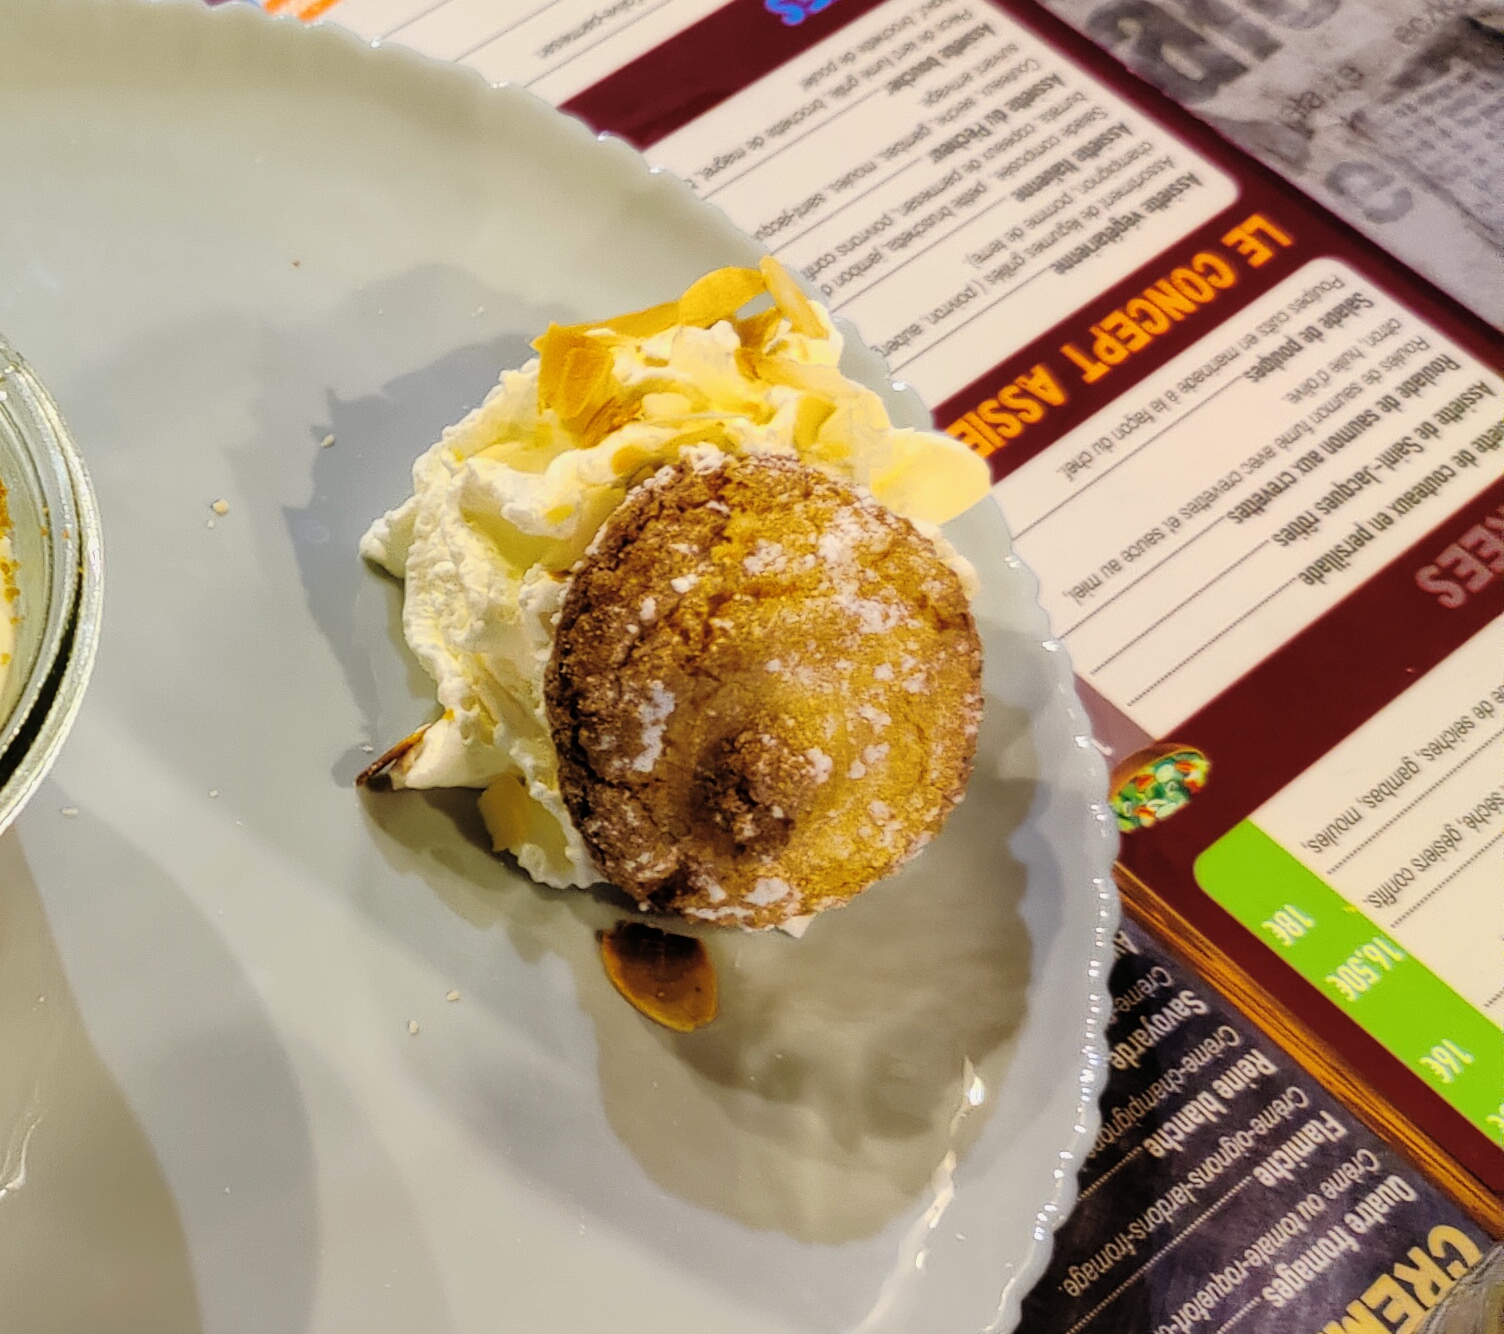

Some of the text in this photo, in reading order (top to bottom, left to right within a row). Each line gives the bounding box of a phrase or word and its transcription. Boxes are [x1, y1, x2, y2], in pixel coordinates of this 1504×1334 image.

[1143, 173, 1202, 213] Assiette
[1288, 274, 1346, 314] Poulpes
[941, 215, 1291, 458] LE CONCEPT ASSIE
[1237, 332, 1259, 351] en
[1242, 292, 1374, 383] Salade de poulpes
[1177, 348, 1240, 394] marinade
[1328, 347, 1366, 374] huile
[1361, 368, 1384, 387] de
[1110, 408, 1156, 441] façon
[1310, 382, 1364, 424] saumon
[1091, 436, 1117, 457] du
[1227, 354, 1460, 524] Roulade de saumon aux crevettes
[1274, 420, 1315, 450] fumé
[1240, 445, 1277, 475] avec
[1273, 382, 1495, 549] Assiette de Saint-Jacques rôties
[1180, 471, 1243, 520] crevettes
[1296, 420, 1504, 585] siette de couteaux en persillade
[1121, 527, 1166, 563] sauce
[1162, 516, 1184, 534] et
[1099, 559, 1123, 579] au
[1416, 502, 1504, 611] EES
[1471, 700, 1497, 721] de
[1358, 756, 1421, 809] gambas,
[1297, 803, 1368, 861] moules,
[1409, 823, 1463, 872] gésiers
[1262, 903, 1314, 946] 18€
[1099, 990, 1209, 1069] Savoyarde
[1419, 1039, 1472, 1084] 16€
[1144, 1049, 1278, 1158] Reine blanche
[1253, 1111, 1346, 1188] Flamiche
[1065, 1087, 1309, 1295] Crème-oignons-lardons-fromage.
[1320, 1148, 1381, 1201] Crème
[1296, 1192, 1326, 1221] ou
[1262, 1175, 1417, 1307] Quatre fromages
